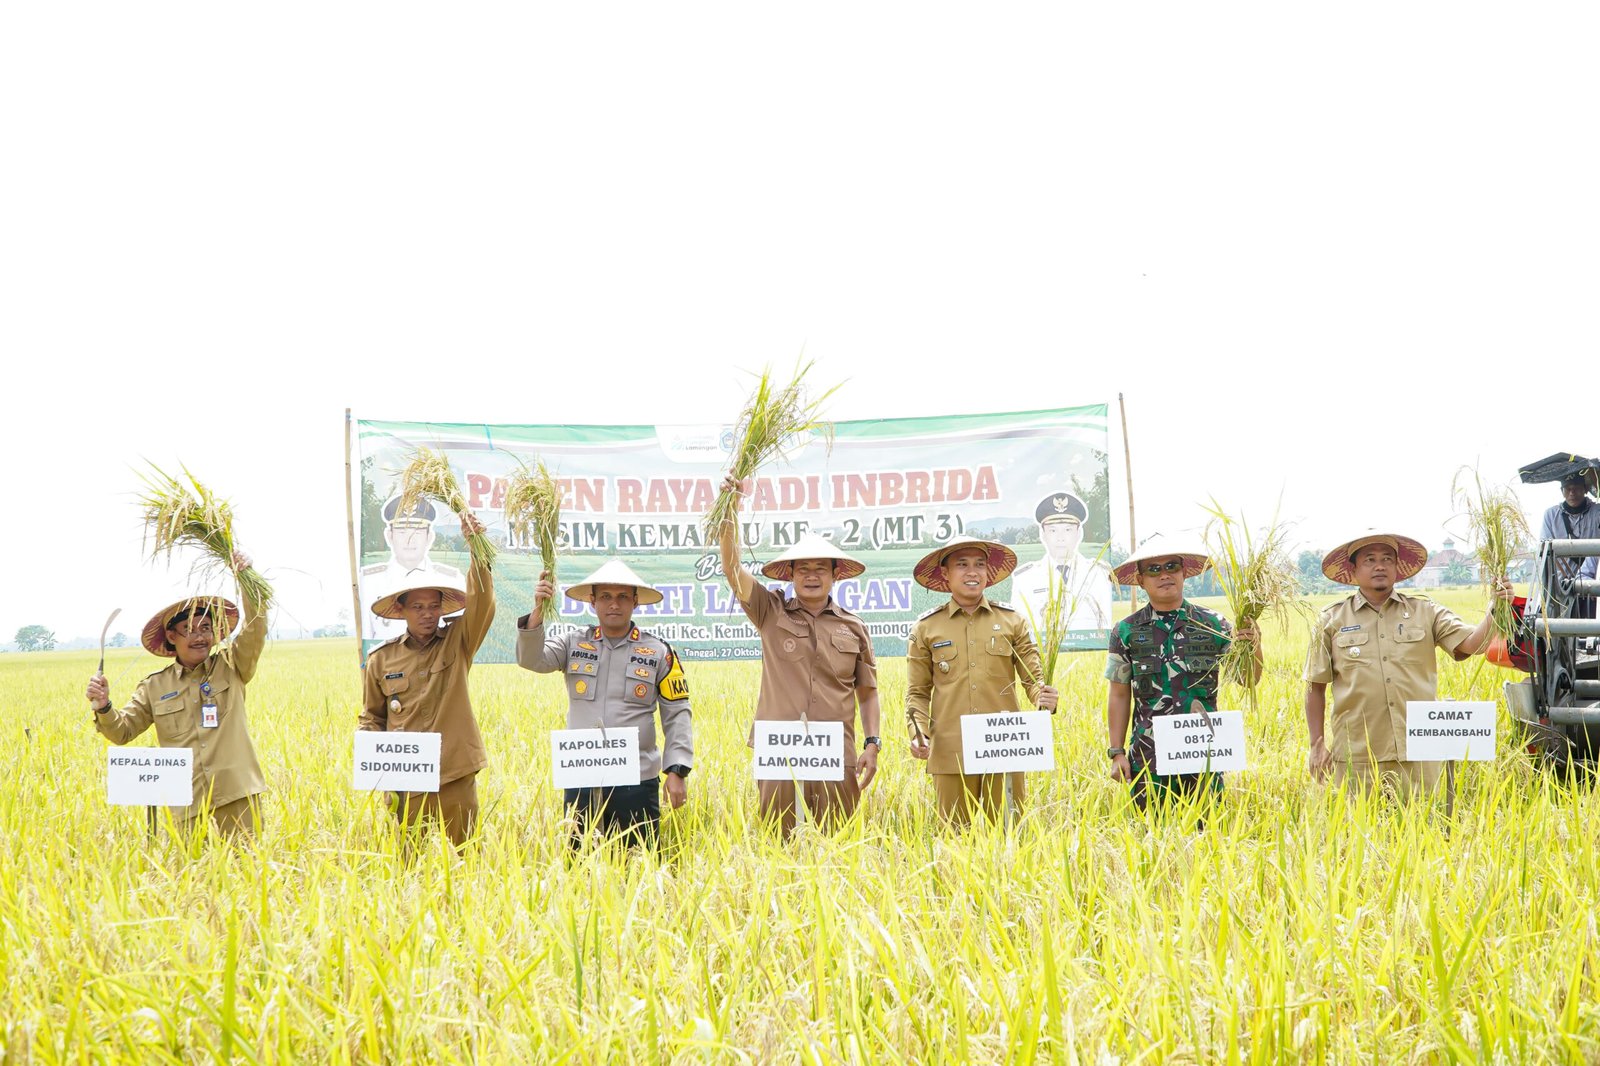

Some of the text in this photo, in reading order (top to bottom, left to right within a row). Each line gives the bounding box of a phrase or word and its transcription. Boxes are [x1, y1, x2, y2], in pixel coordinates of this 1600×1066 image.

[466, 473, 605, 512] PAEN
[831, 465, 999, 508] INBRIDA
[843, 518, 860, 544] 2
[872, 514, 925, 547] (MT
[935, 513, 964, 540] 3)
[680, 625, 710, 639] Kec.
[571, 650, 599, 661] AGUS.DS
[684, 648, 720, 658] Tanggal,
[721, 648, 732, 657] 27
[630, 656, 658, 668] POLRI
[986, 716, 1027, 727] WAKIL
[1428, 711, 1473, 721] CAMAT
[984, 731, 1030, 743] BUPATI
[1184, 733, 1214, 744] 0812
[1409, 728, 1492, 737] KEMBANGBAHU
[559, 739, 627, 751] KAPOLRES
[768, 733, 831, 747] BUPATI
[375, 743, 420, 754] KADES
[974, 746, 1044, 759] LAMONGAN
[1167, 748, 1233, 761] LAMONGAN
[110, 757, 187, 767] KEPALA DINAS
[360, 761, 434, 773] SIDOMUKTI
[560, 757, 627, 769] LAMONGAN
[758, 756, 840, 768] LAMONGAN
[138, 774, 160, 783] KPP
